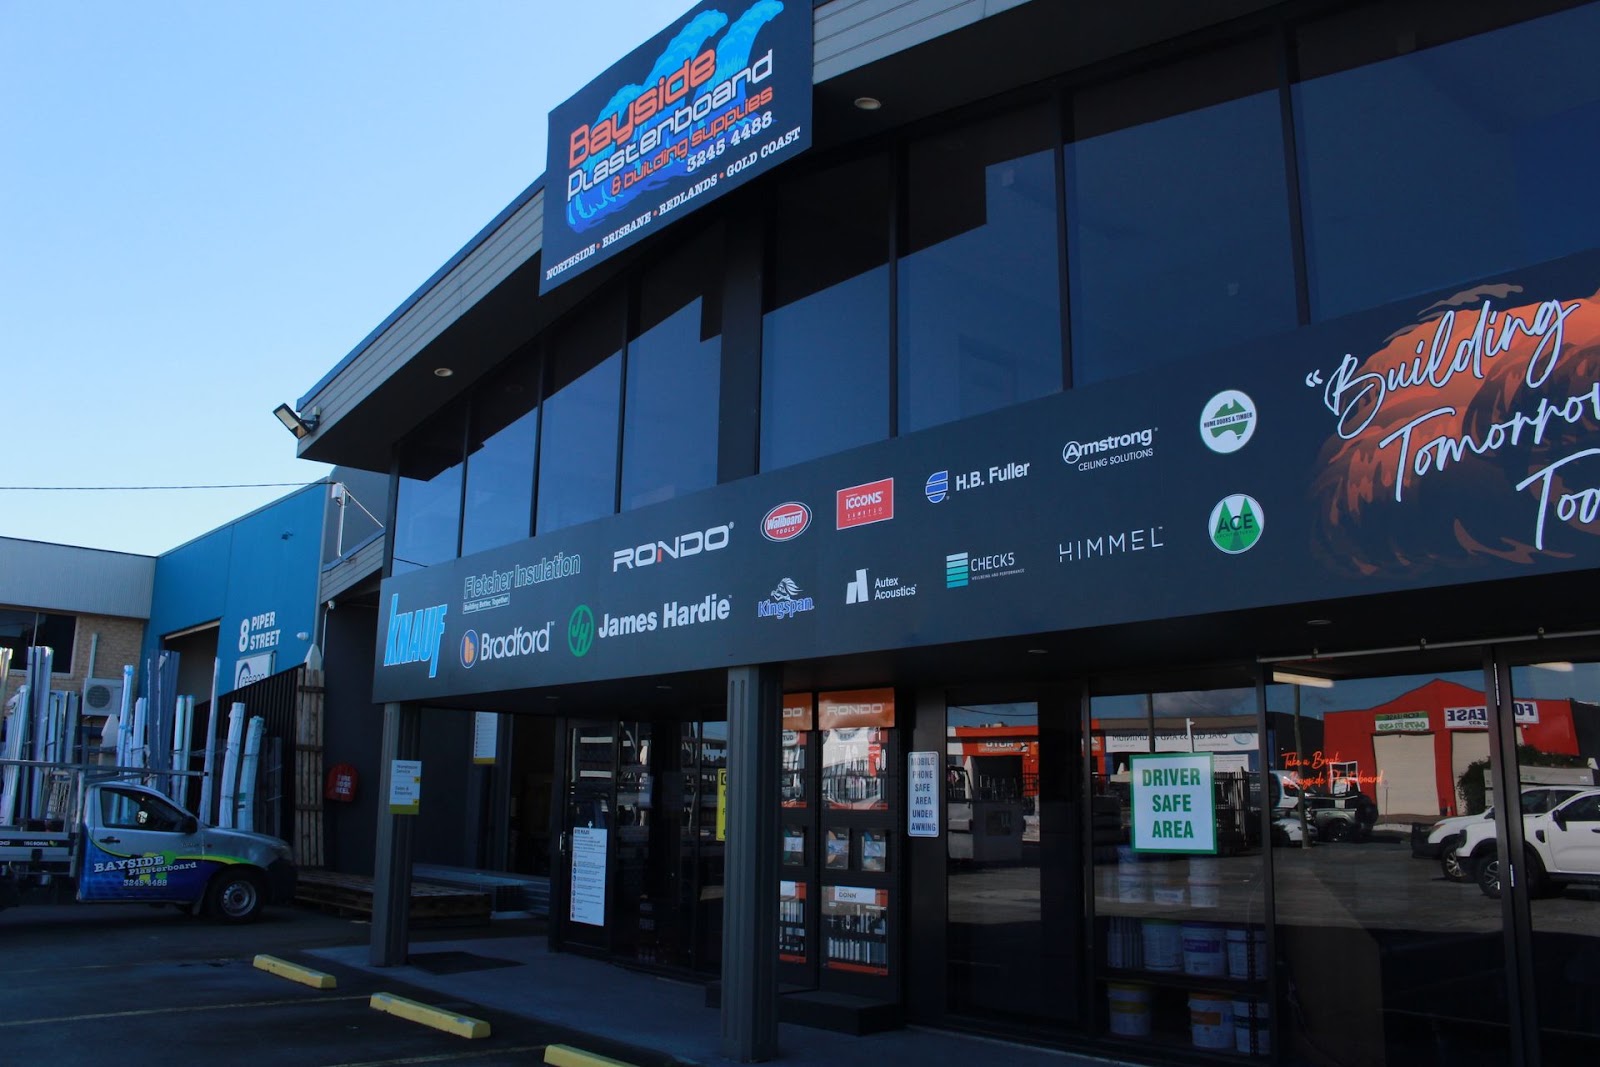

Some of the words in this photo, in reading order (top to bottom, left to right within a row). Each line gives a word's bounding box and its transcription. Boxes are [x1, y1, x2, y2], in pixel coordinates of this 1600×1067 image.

[568, 49, 716, 169] Bayside
[567, 49, 773, 202] Plasterboard
[611, 178, 622, 196] &
[623, 138, 689, 190] building
[691, 86, 773, 149] supplies
[686, 138, 726, 173] 3245
[730, 111, 773, 147] 4488
[546, 243, 596, 281] NORTHSIDE
[601, 211, 652, 248] BRISBANE
[658, 174, 718, 216] REDLANDS
[726, 151, 758, 178] GOLD
[760, 127, 801, 158] COAST
[1236, 412, 1253, 421] TIMBER
[1062, 428, 1153, 464] Armstrong
[1379, 382, 1600, 503] Tomorro
[1078, 457, 1108, 472] CEILING
[1109, 448, 1154, 465] SOLUTIONS
[955, 472, 984, 491] H.B.
[989, 462, 1030, 485] Fuller
[767, 510, 803, 531] Wallboard
[776, 526, 795, 535] TOOLS
[1217, 513, 1253, 533] ACE
[613, 524, 730, 573] RONDO
[1059, 528, 1164, 563] HIMMEL
[463, 570, 514, 600] Fletcher
[514, 551, 581, 588] Insulation
[874, 577, 899, 589] Autex
[874, 585, 916, 600] Acoustics
[598, 609, 658, 639] James
[663, 593, 731, 630] Hardie
[757, 595, 813, 620] Kingspan
[251, 611, 276, 632] PIPER
[238, 618, 250, 653] 8
[249, 629, 281, 651] STREET
[383, 593, 448, 680] KNAUF
[480, 621, 551, 662] Bradford
[827, 702, 883, 716] RONDO
[911, 757, 935, 766] MOBILE
[912, 770, 933, 779] PHONE
[1142, 767, 1201, 787] DRIVER
[914, 783, 930, 792] SAFE
[915, 796, 932, 805] AREA
[1152, 794, 1192, 813] SAFE
[912, 809, 933, 818] UNDER
[911, 822, 936, 832] AWNING
[1151, 820, 1194, 839] AREA
[93, 855, 165, 873] BAYSIDE
[128, 861, 198, 876] Plasterboard
[122, 879, 144, 887] 3245
[147, 879, 168, 887] 4488
